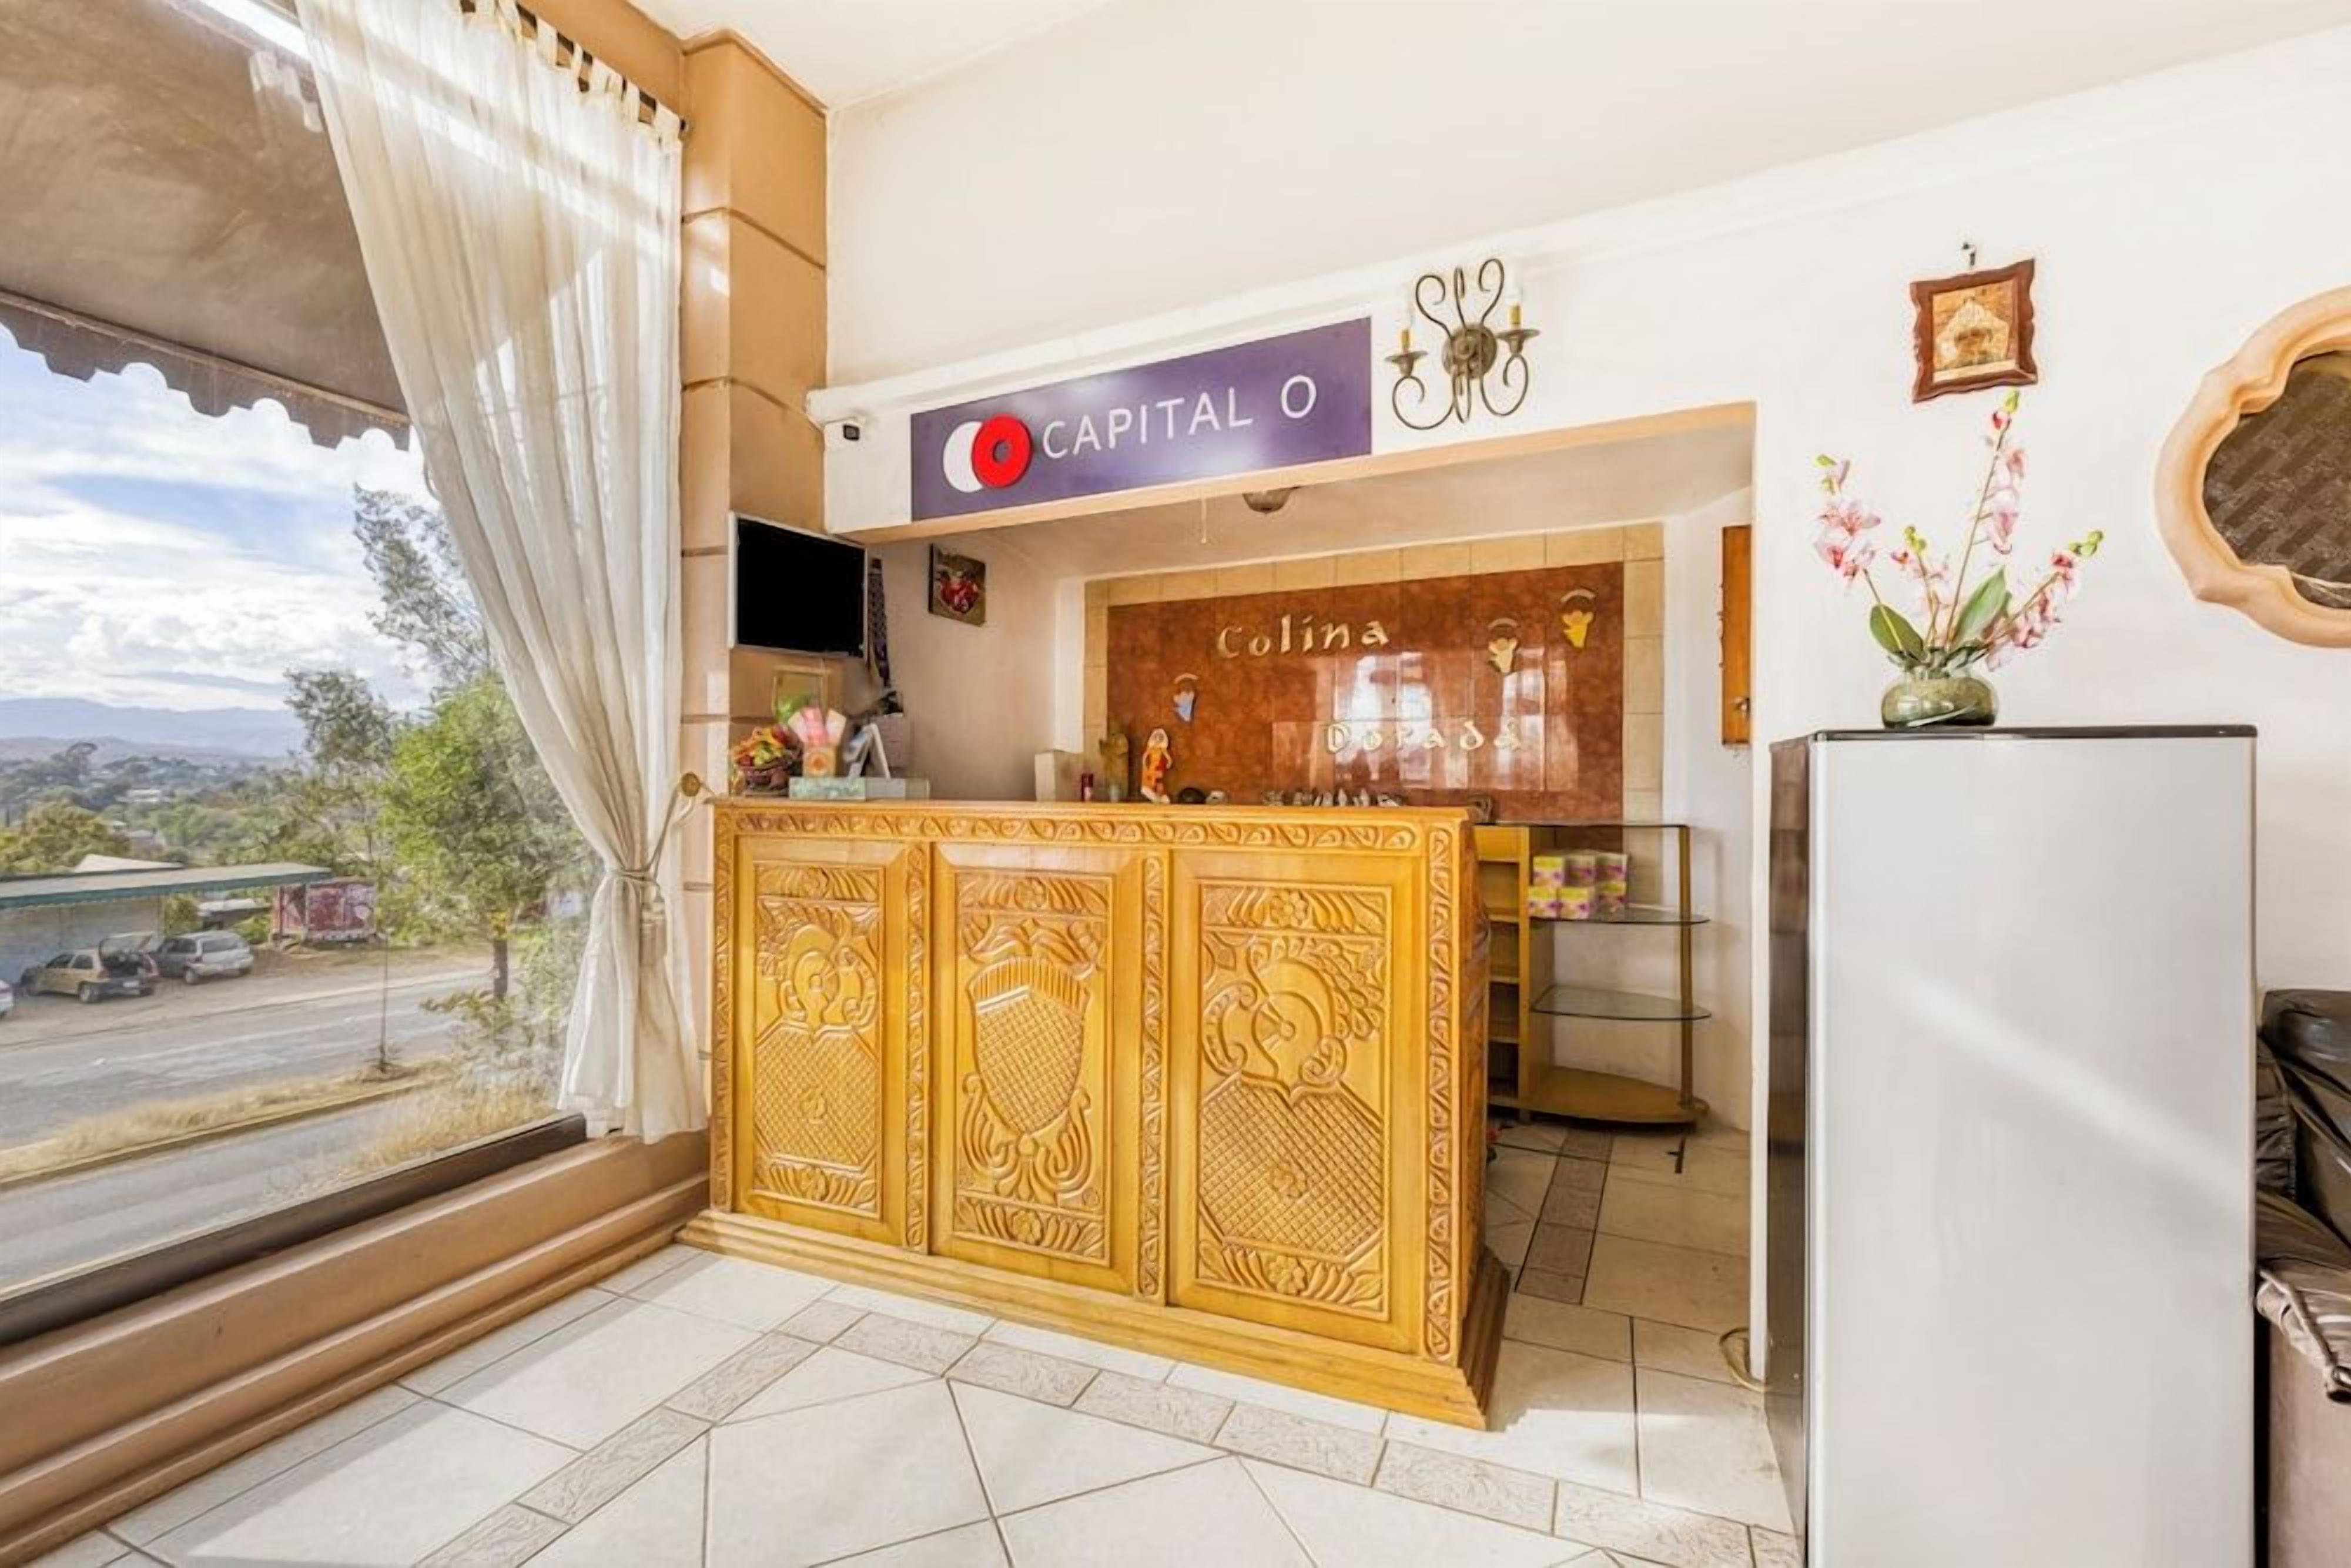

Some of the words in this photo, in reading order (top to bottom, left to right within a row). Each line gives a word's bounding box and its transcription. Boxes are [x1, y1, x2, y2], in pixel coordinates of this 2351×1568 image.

[1042, 387, 1254, 459] CAPITAL
[1281, 374, 1317, 419] O
[1217, 614, 1389, 659] Colina
